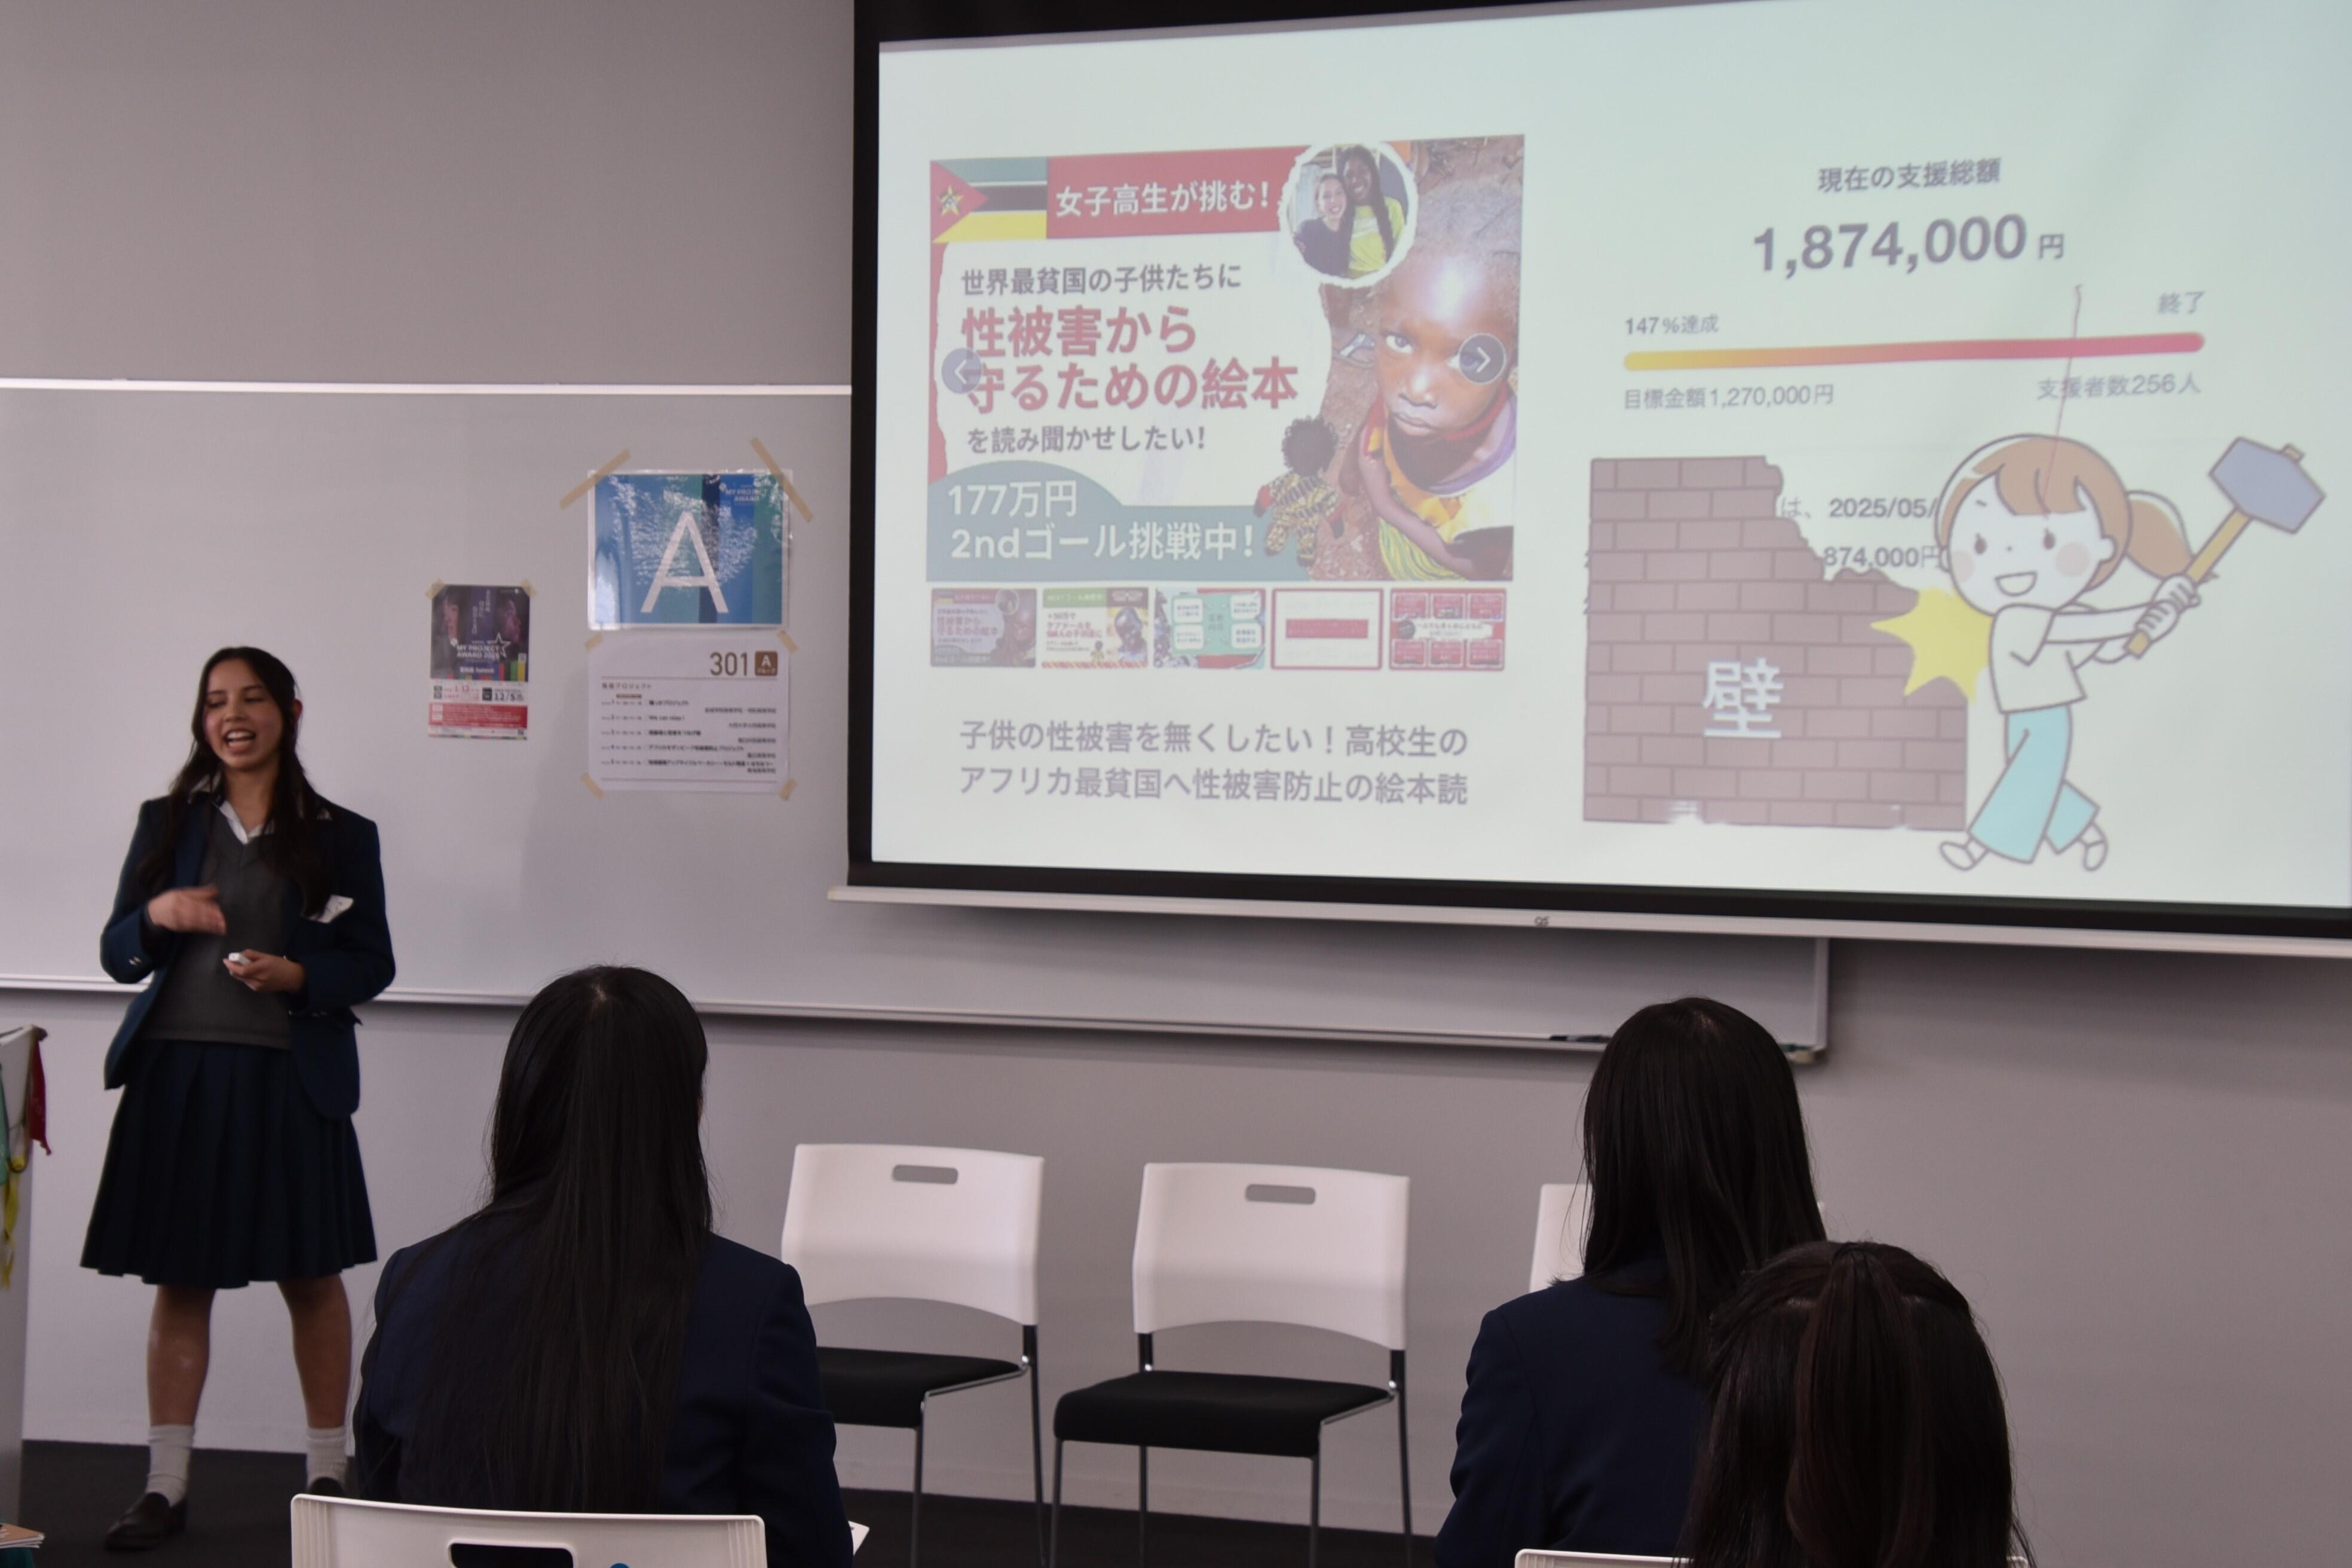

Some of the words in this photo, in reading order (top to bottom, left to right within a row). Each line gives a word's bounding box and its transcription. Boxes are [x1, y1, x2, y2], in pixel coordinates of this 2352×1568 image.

[1818, 157, 2001, 192] 現在の支援総額
[1056, 180, 1269, 218] 女子高生が挑む!
[961, 264, 1242, 296] 世界最貧国の子供たちに
[2157, 290, 2206, 315] 終了
[961, 305, 1196, 358] 性被害から
[961, 356, 1298, 414] 守るための絵本
[1624, 384, 1834, 410] 目標金額1,270,000円
[2036, 372, 2201, 401] 支援者数256人
[967, 426, 1205, 454] を読み聞かせしたい!
[948, 480, 1077, 518] 177万円
[641, 511, 729, 613] A
[709, 651, 748, 676] 301
[761, 655, 771, 667] A
[1703, 657, 1784, 739] 壁
[960, 720, 1468, 757] 子供の性被害を無くしたい！高校生の
[960, 767, 1468, 805] アフリカ最貧国へ性被害防止の絵本読
